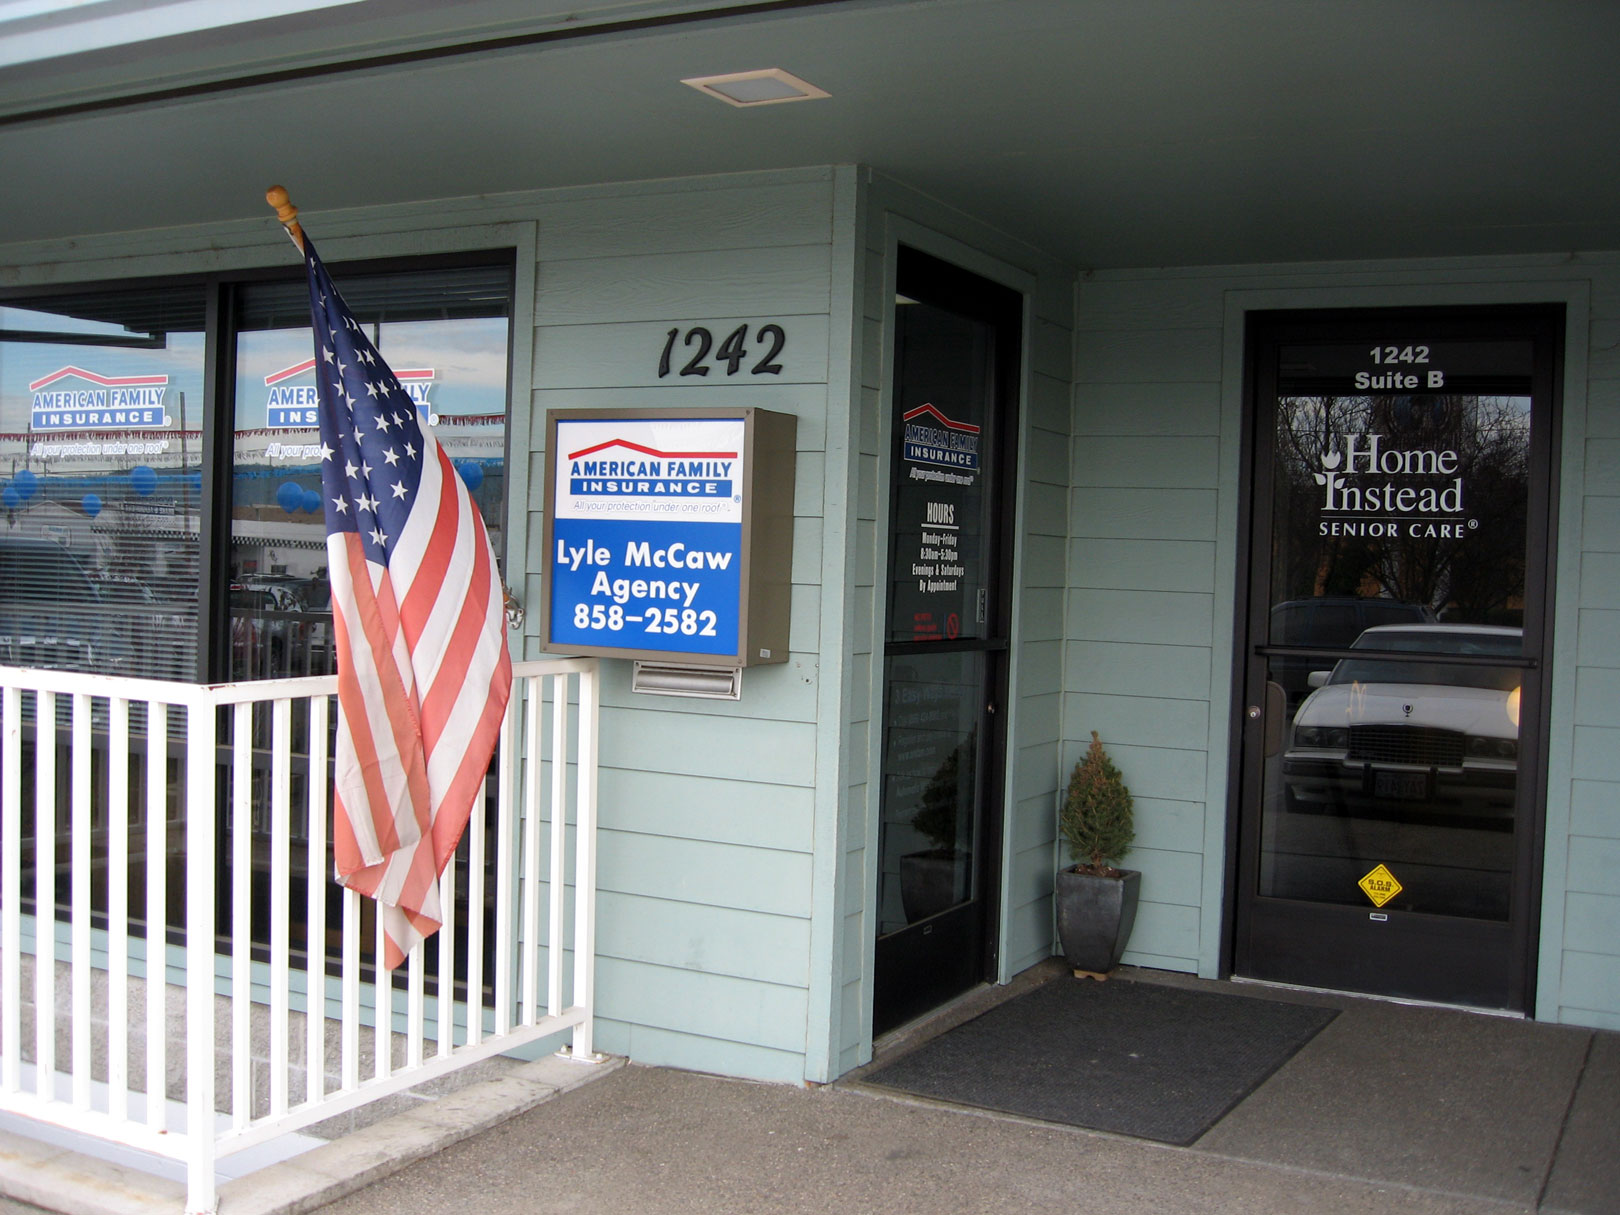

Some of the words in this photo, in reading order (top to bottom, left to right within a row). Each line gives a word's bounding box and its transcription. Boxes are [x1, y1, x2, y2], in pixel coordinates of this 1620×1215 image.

[658, 323, 786, 378] 1242
[1370, 346, 1430, 364] 1242
[1355, 371, 1419, 389] Suite
[1427, 370, 1444, 388] B
[33, 390, 106, 409] AMERICAN
[111, 387, 166, 406] FAMILY
[269, 387, 317, 405] AMER
[42, 410, 153, 425] INSURANCE
[905, 424, 949, 447] AMERICAN
[102, 442, 127, 455] under
[265, 443, 280, 456] All
[280, 445, 304, 460] your
[910, 446, 972, 465] INSURANCE
[1341, 434, 1458, 474] Home
[571, 461, 661, 477] AMERICAN
[667, 461, 732, 478] FAMILY
[582, 482, 718, 494] INSURANCE
[1320, 471, 1464, 512] Instead
[574, 501, 585, 510] All
[586, 502, 605, 512] your
[606, 501, 650, 512] protection
[653, 502, 680, 511] under
[681, 504, 699, 512] one
[927, 502, 955, 524] HOURS
[1319, 522, 1398, 537] SENIOR
[556, 539, 611, 571] Lyle
[624, 541, 732, 570] McCaw
[912, 564, 934, 578] Evenings
[941, 564, 965, 578] Saturdays
[590, 571, 700, 607] Agency
[927, 580, 957, 593] Appointment
[573, 603, 717, 637] 858-2582
